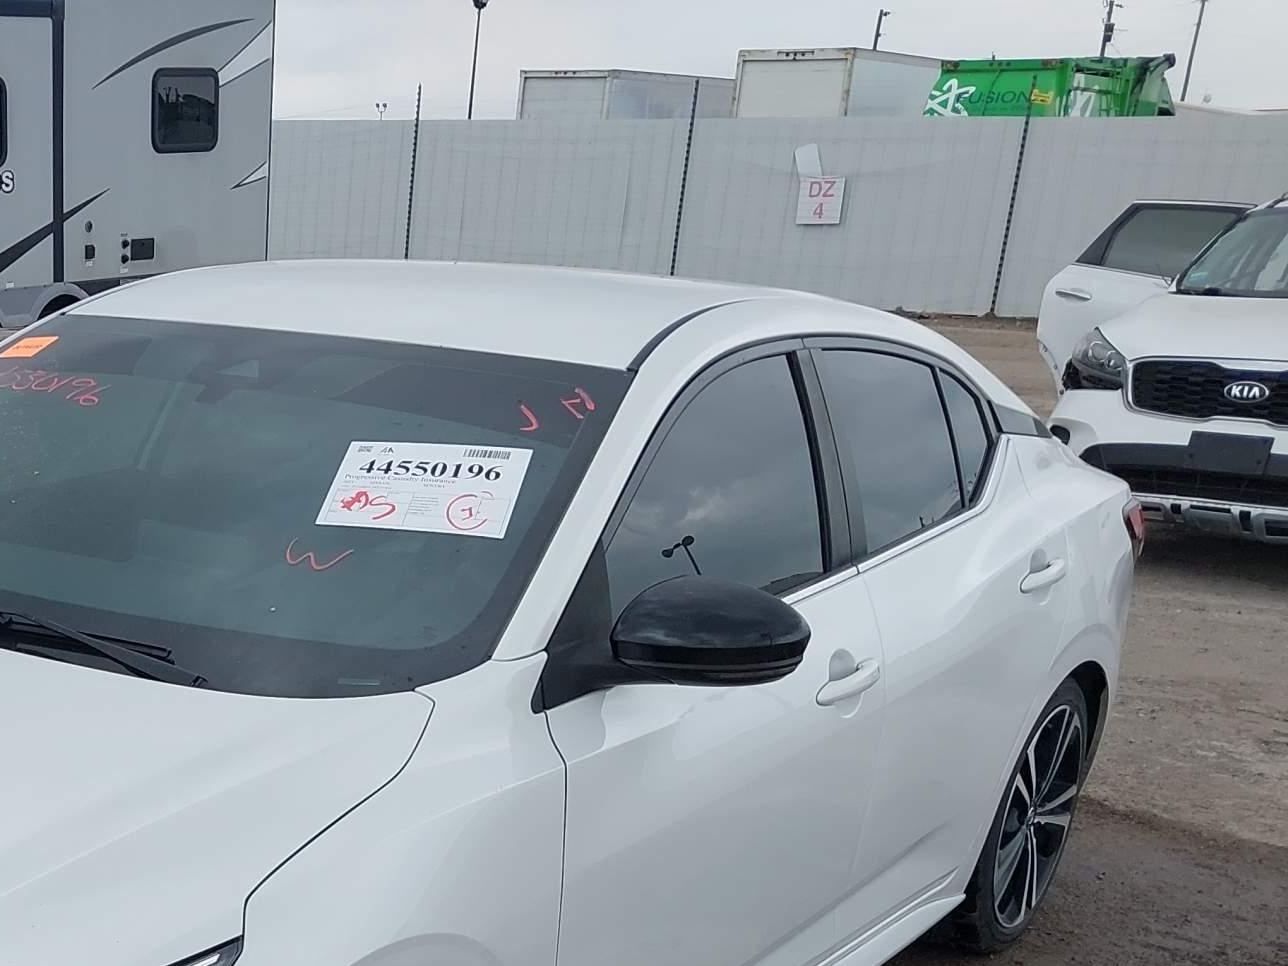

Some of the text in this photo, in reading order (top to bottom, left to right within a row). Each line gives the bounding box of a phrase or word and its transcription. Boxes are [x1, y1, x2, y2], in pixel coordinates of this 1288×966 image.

[808, 180, 836, 198] DZ
[812, 202, 824, 219] 4
[1230, 385, 1260, 398] KIA
[344, 473, 386, 481] Progressive
[358, 459, 504, 481] 44550196
